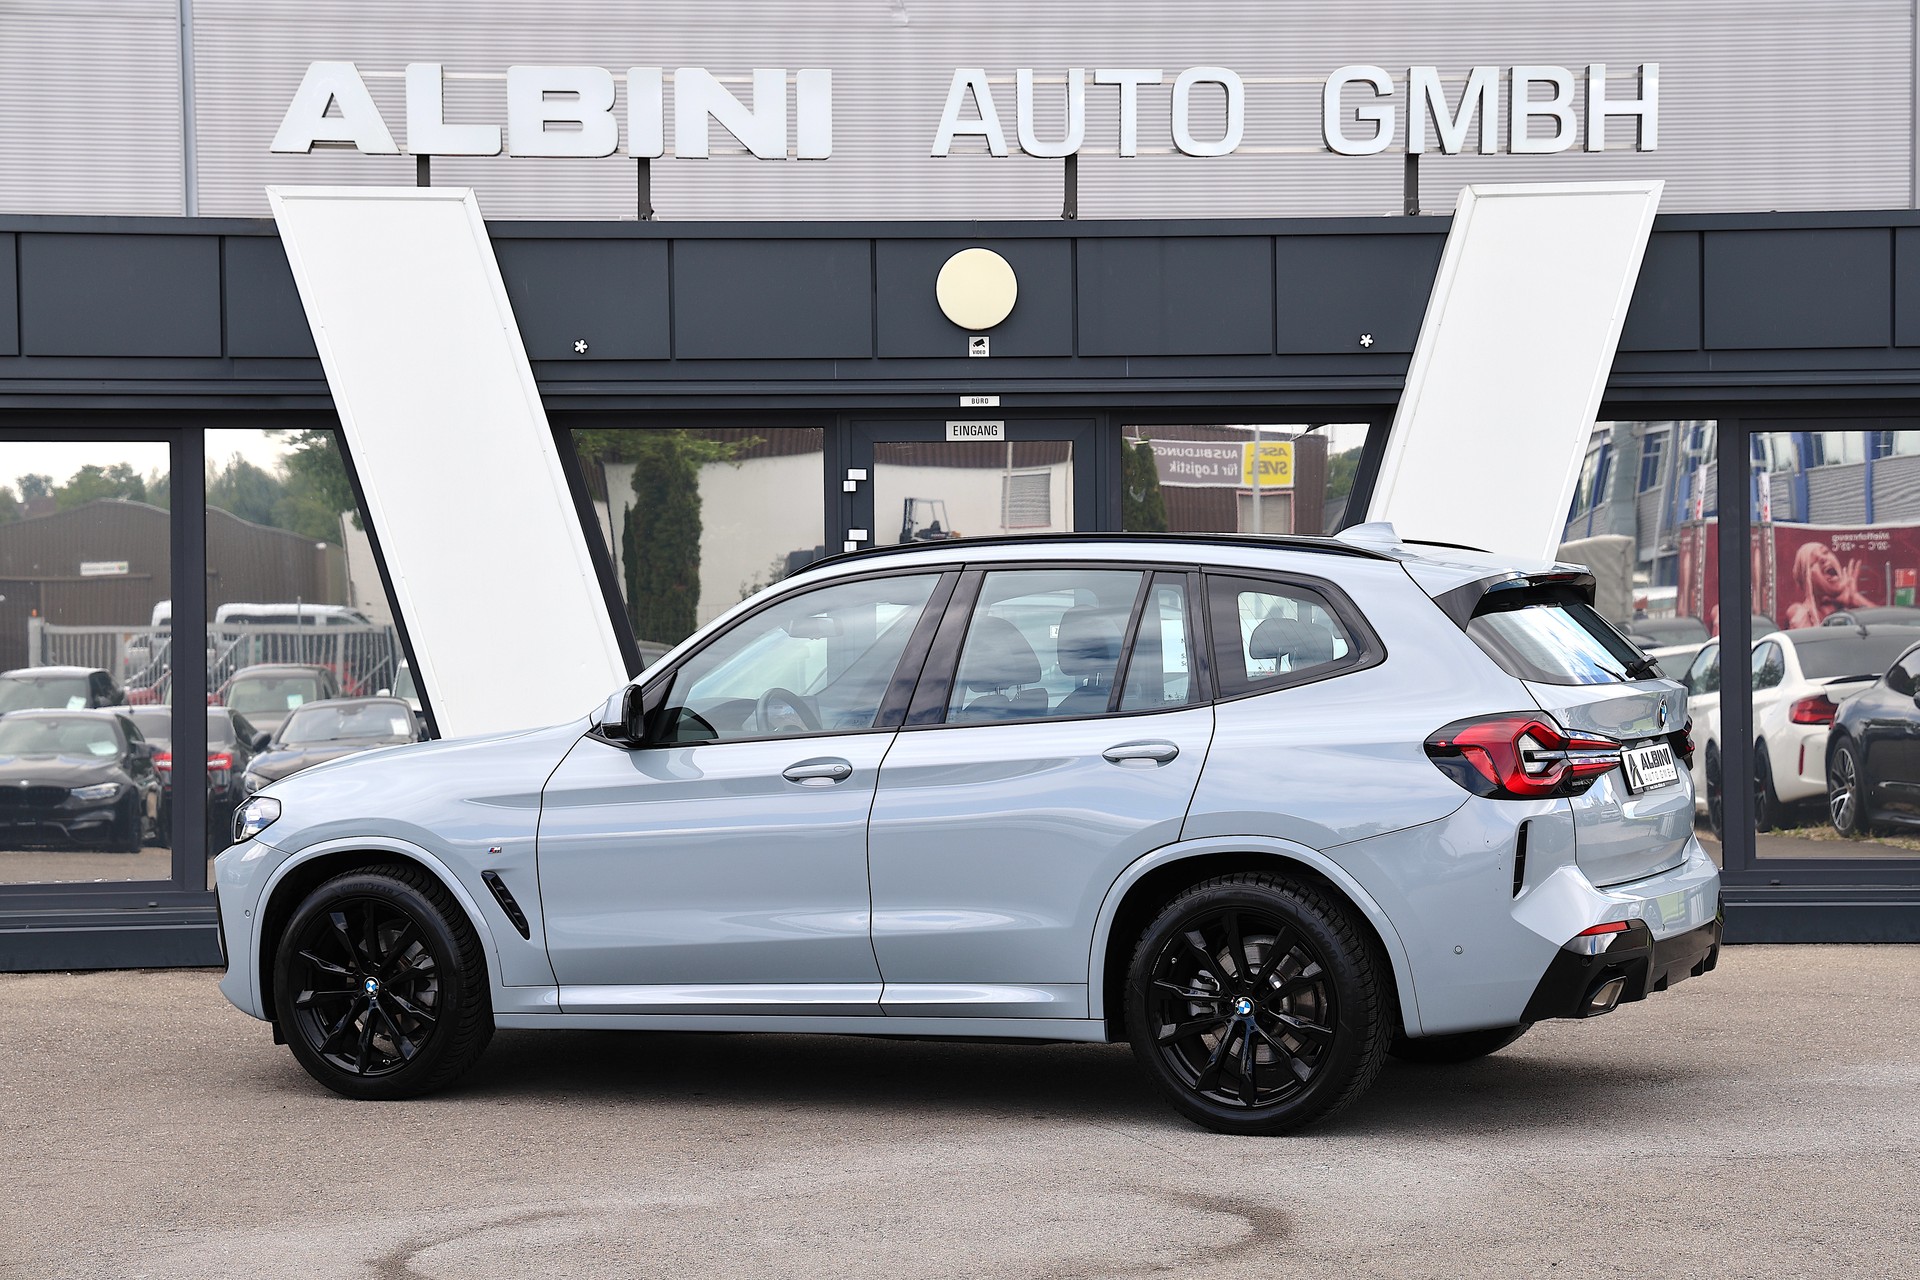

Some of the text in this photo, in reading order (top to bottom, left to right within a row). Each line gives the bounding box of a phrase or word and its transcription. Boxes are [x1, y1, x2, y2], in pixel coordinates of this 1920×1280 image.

[269, 61, 1660, 160] ALBINI AUTO GMBH
[953, 425, 998, 436] EINGANG
[1640, 748, 1671, 771] ALBINI
